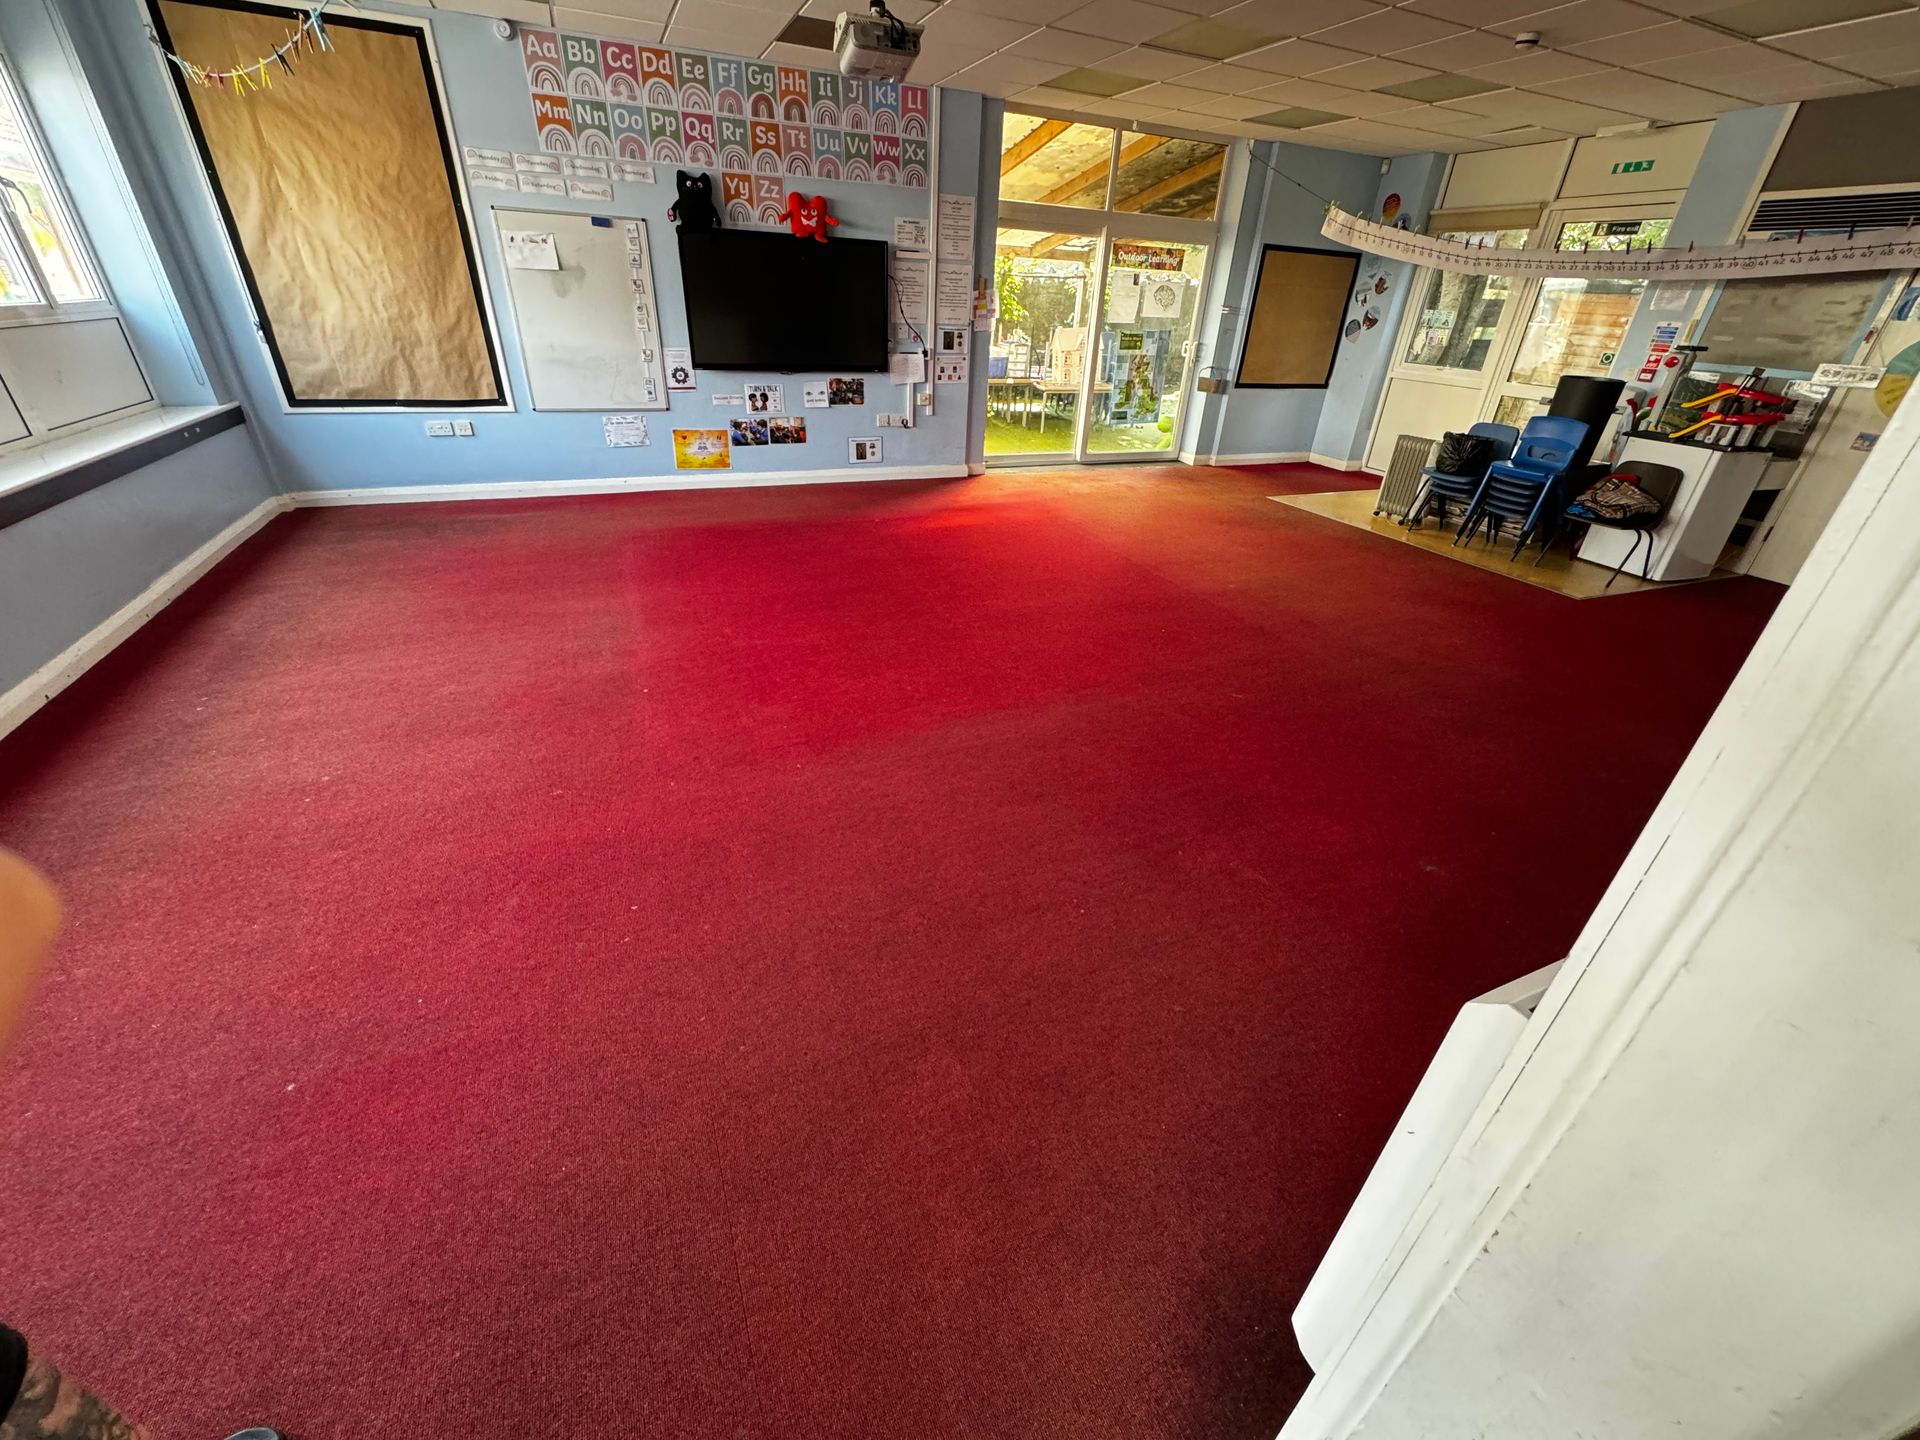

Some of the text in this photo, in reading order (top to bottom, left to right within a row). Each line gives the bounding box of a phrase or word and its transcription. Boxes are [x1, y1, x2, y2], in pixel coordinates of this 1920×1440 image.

[526, 34, 922, 110] Aa Bb Cc Dd Ee Ff Gg Hh Ii Jj Kk Ll
[534, 100, 925, 161] Mm Nn Oo Pp Qq Rr Ss Tt Uu Vv Ww Xx
[726, 176, 780, 200] Yy Zz
[1118, 251, 1179, 266] Outdoor Learning
